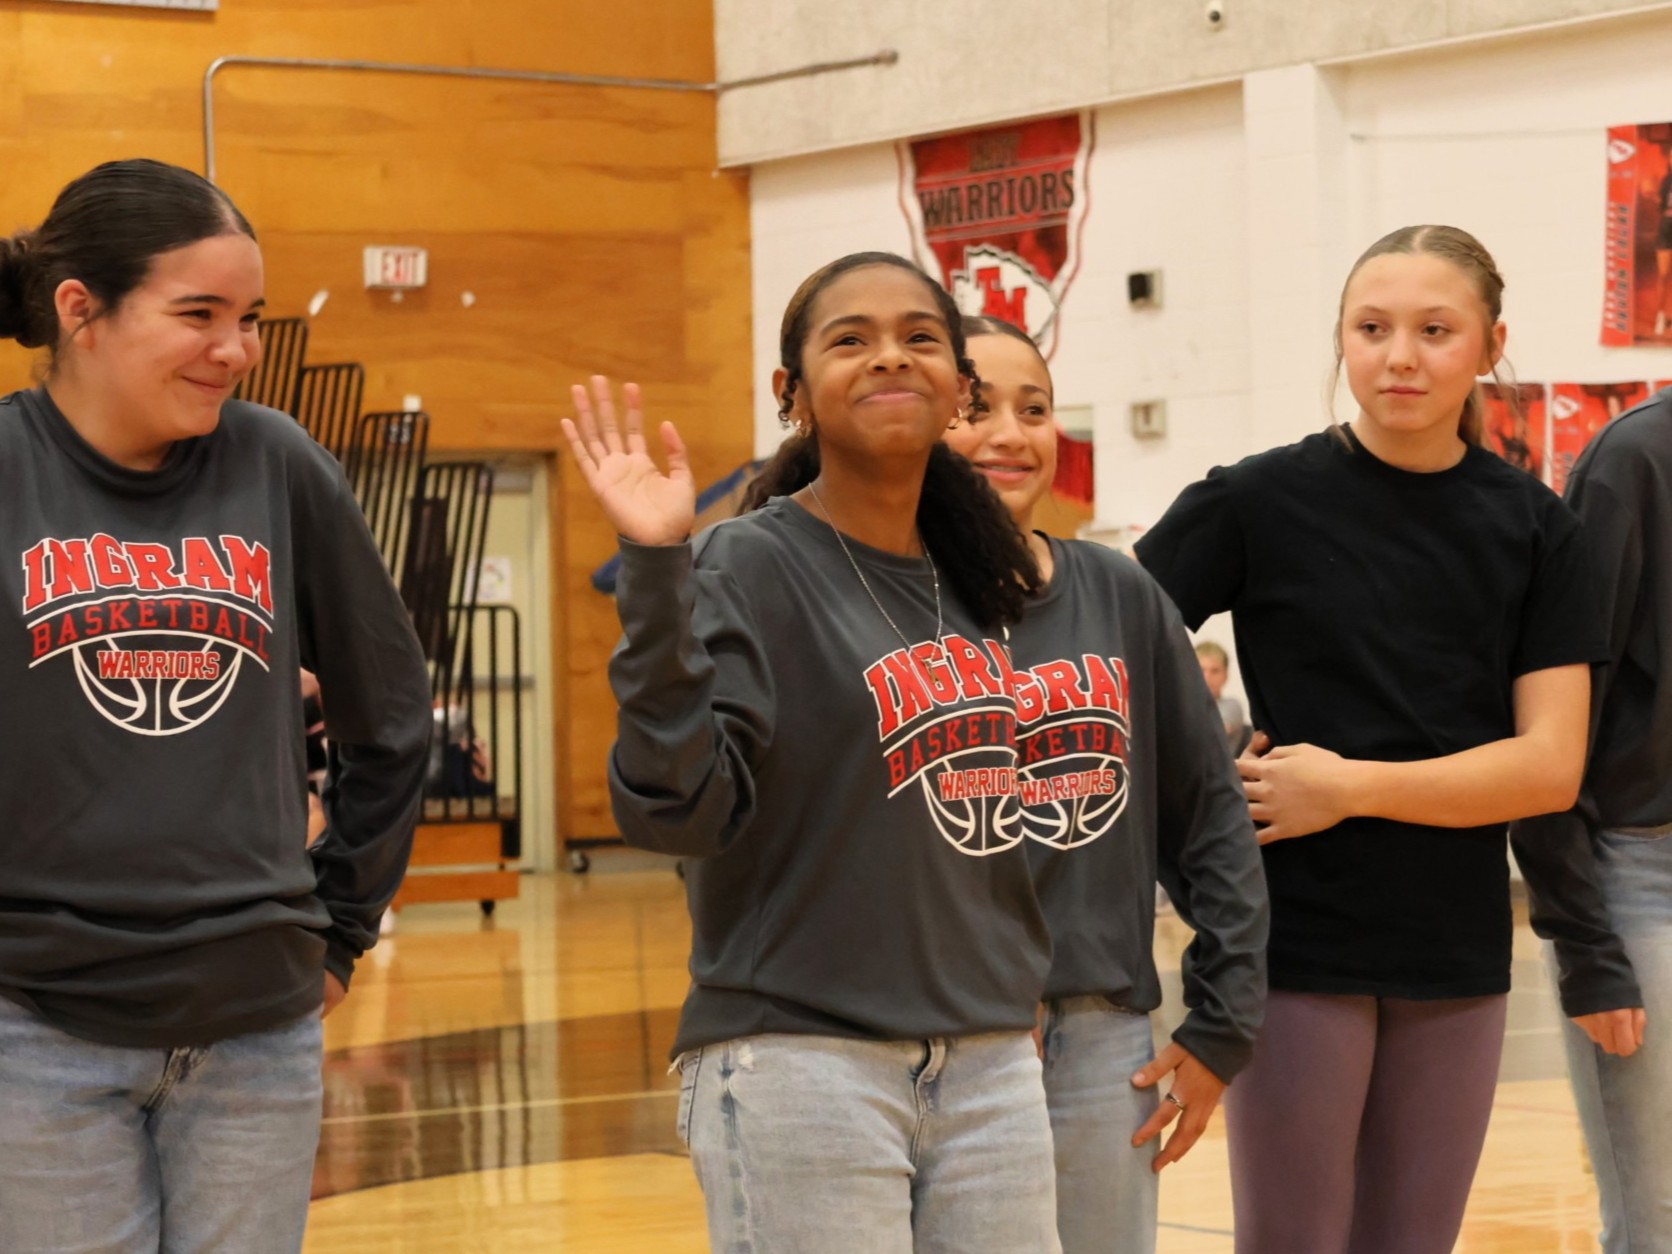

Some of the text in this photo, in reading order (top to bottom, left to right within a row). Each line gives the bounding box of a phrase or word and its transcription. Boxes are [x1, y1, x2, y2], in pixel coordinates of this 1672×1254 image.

[919, 169, 1075, 226] WARRIORS
[22, 533, 274, 619] INGRAM
[32, 599, 270, 661] BASKETBALL
[97, 650, 220, 680] WARRIORS
